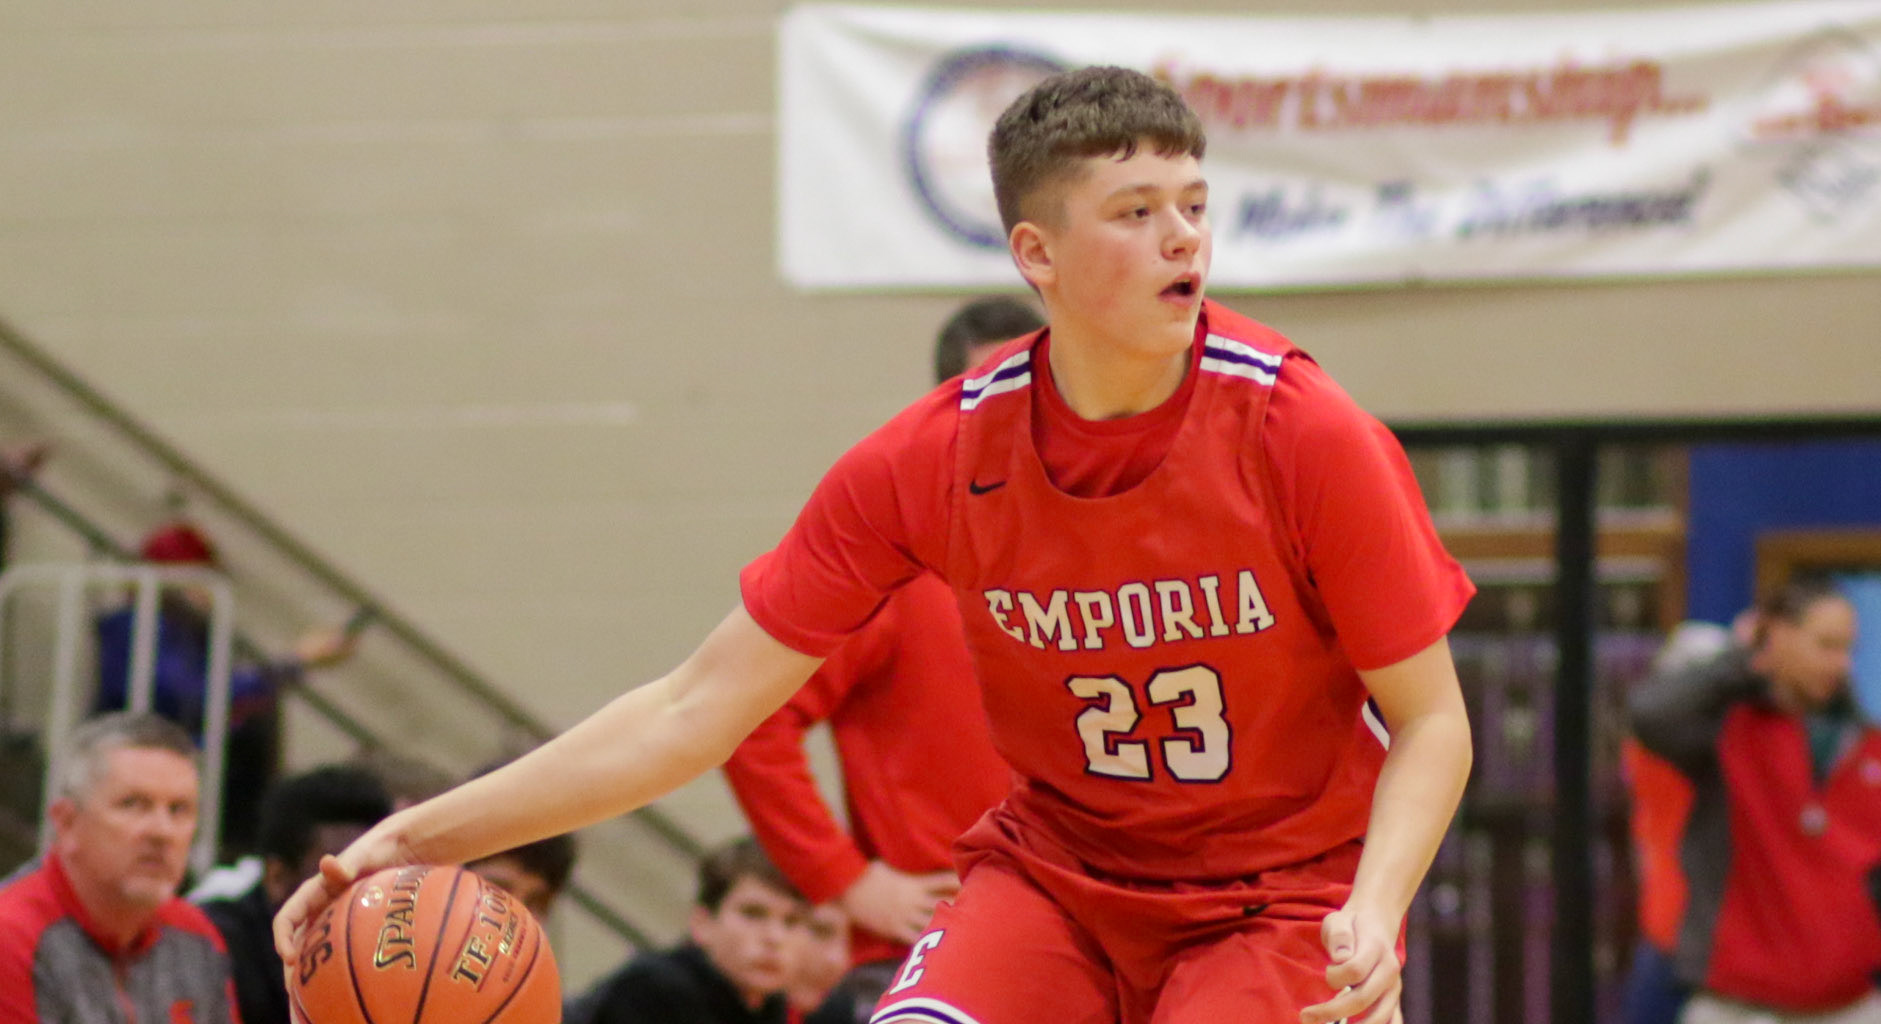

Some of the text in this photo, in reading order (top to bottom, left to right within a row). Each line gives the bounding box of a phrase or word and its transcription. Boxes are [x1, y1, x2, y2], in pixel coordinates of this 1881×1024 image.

[983, 569, 1276, 651] EMPORIA
[1064, 662, 1234, 784] 23
[374, 867, 428, 971] SPALD
[888, 928, 946, 995] E
